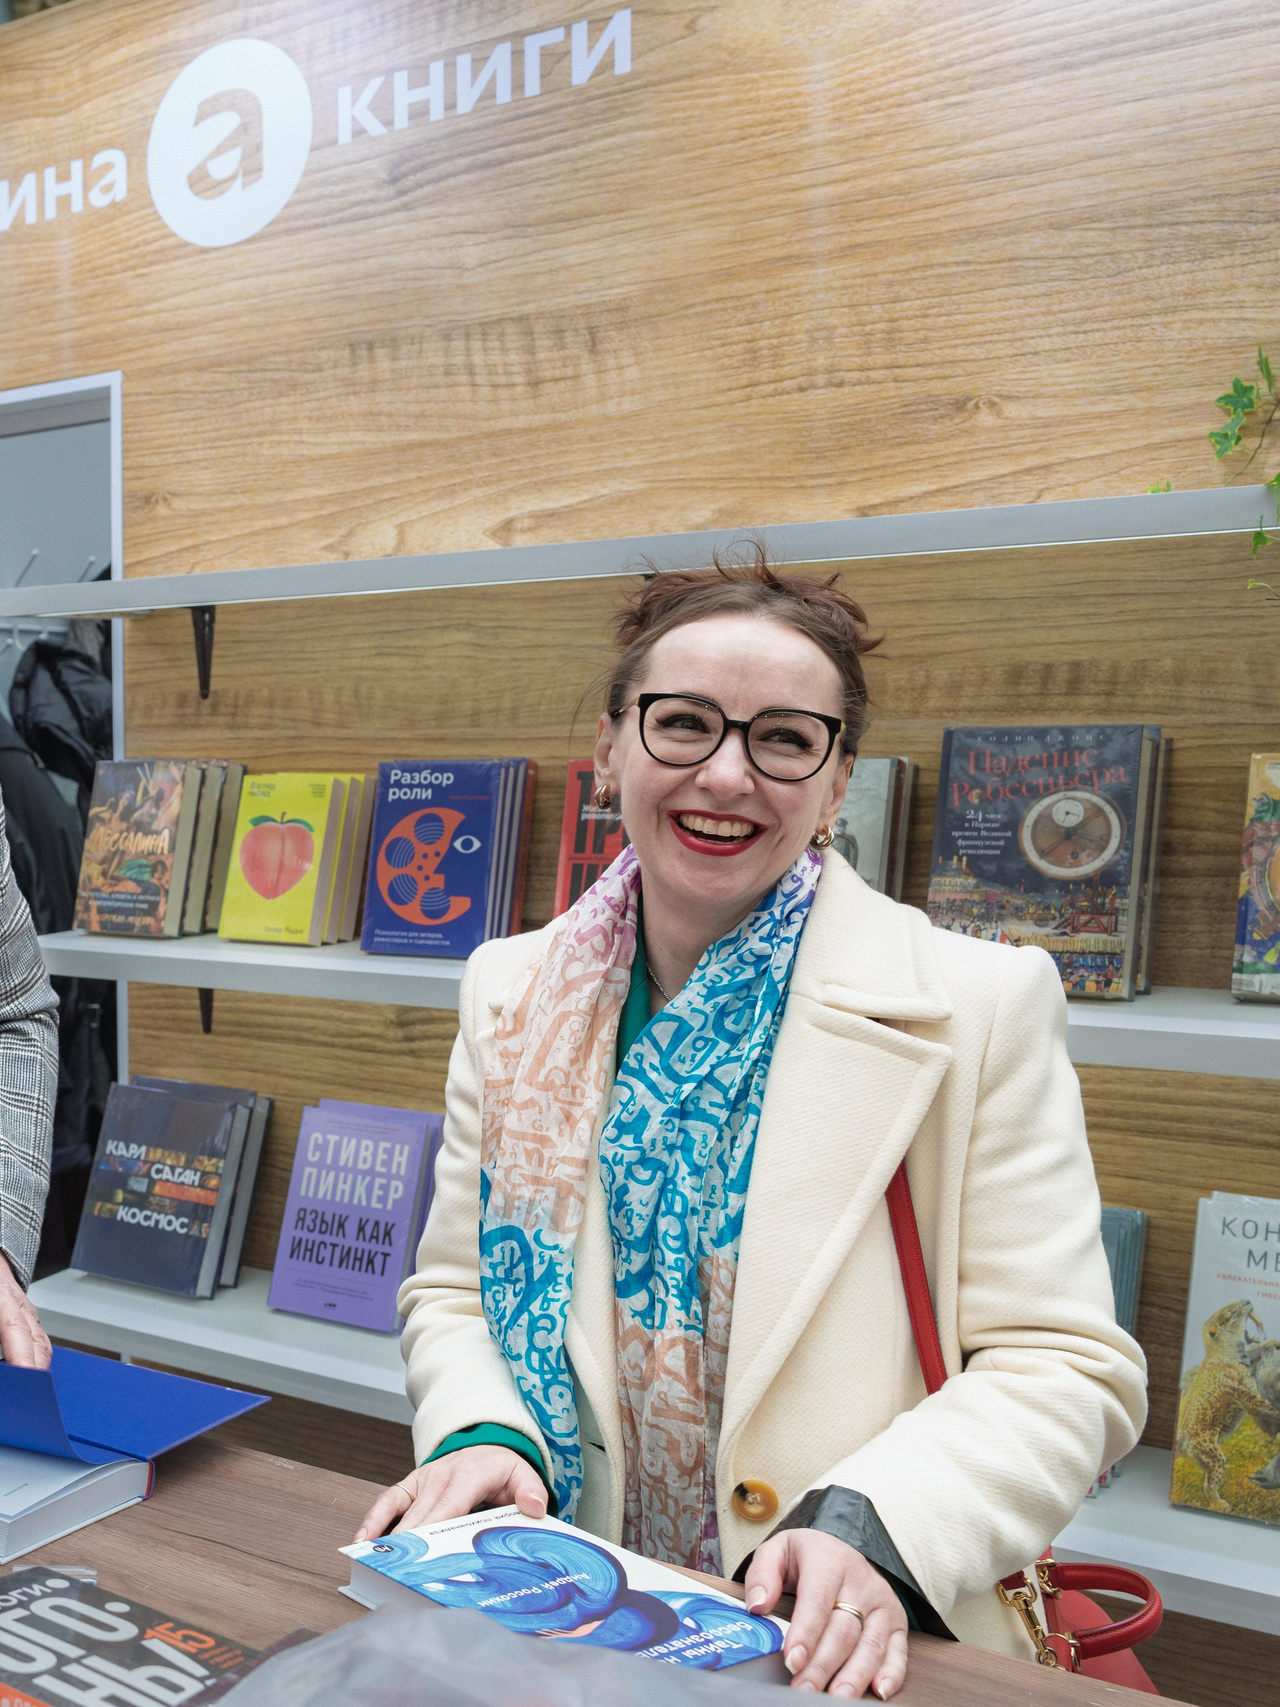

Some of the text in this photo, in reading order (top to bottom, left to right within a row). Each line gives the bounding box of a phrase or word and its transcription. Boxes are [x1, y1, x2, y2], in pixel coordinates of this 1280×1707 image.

[337, 8, 634, 146] книги
[390, 769, 455, 787] Разбор
[967, 748, 1100, 777] Падение
[388, 787, 433, 802] роли
[951, 765, 1129, 808] Робеспьера
[966, 809, 983, 822] 24
[105, 1139, 148, 1160] КАРЛ
[307, 1131, 410, 1176] СТИВЕН
[150, 1163, 202, 1186] САГАН
[299, 1166, 405, 1211] ПИНКЕР
[116, 1205, 190, 1235] КОСМОС
[294, 1207, 396, 1247] ЯЗЫК КАК
[289, 1236, 392, 1277] ИНСТИНКТ
[477, 1572, 592, 1609] Андрей Россохин
[143, 1621, 217, 1655] 15
[680, 1638, 745, 1660] Тайны
